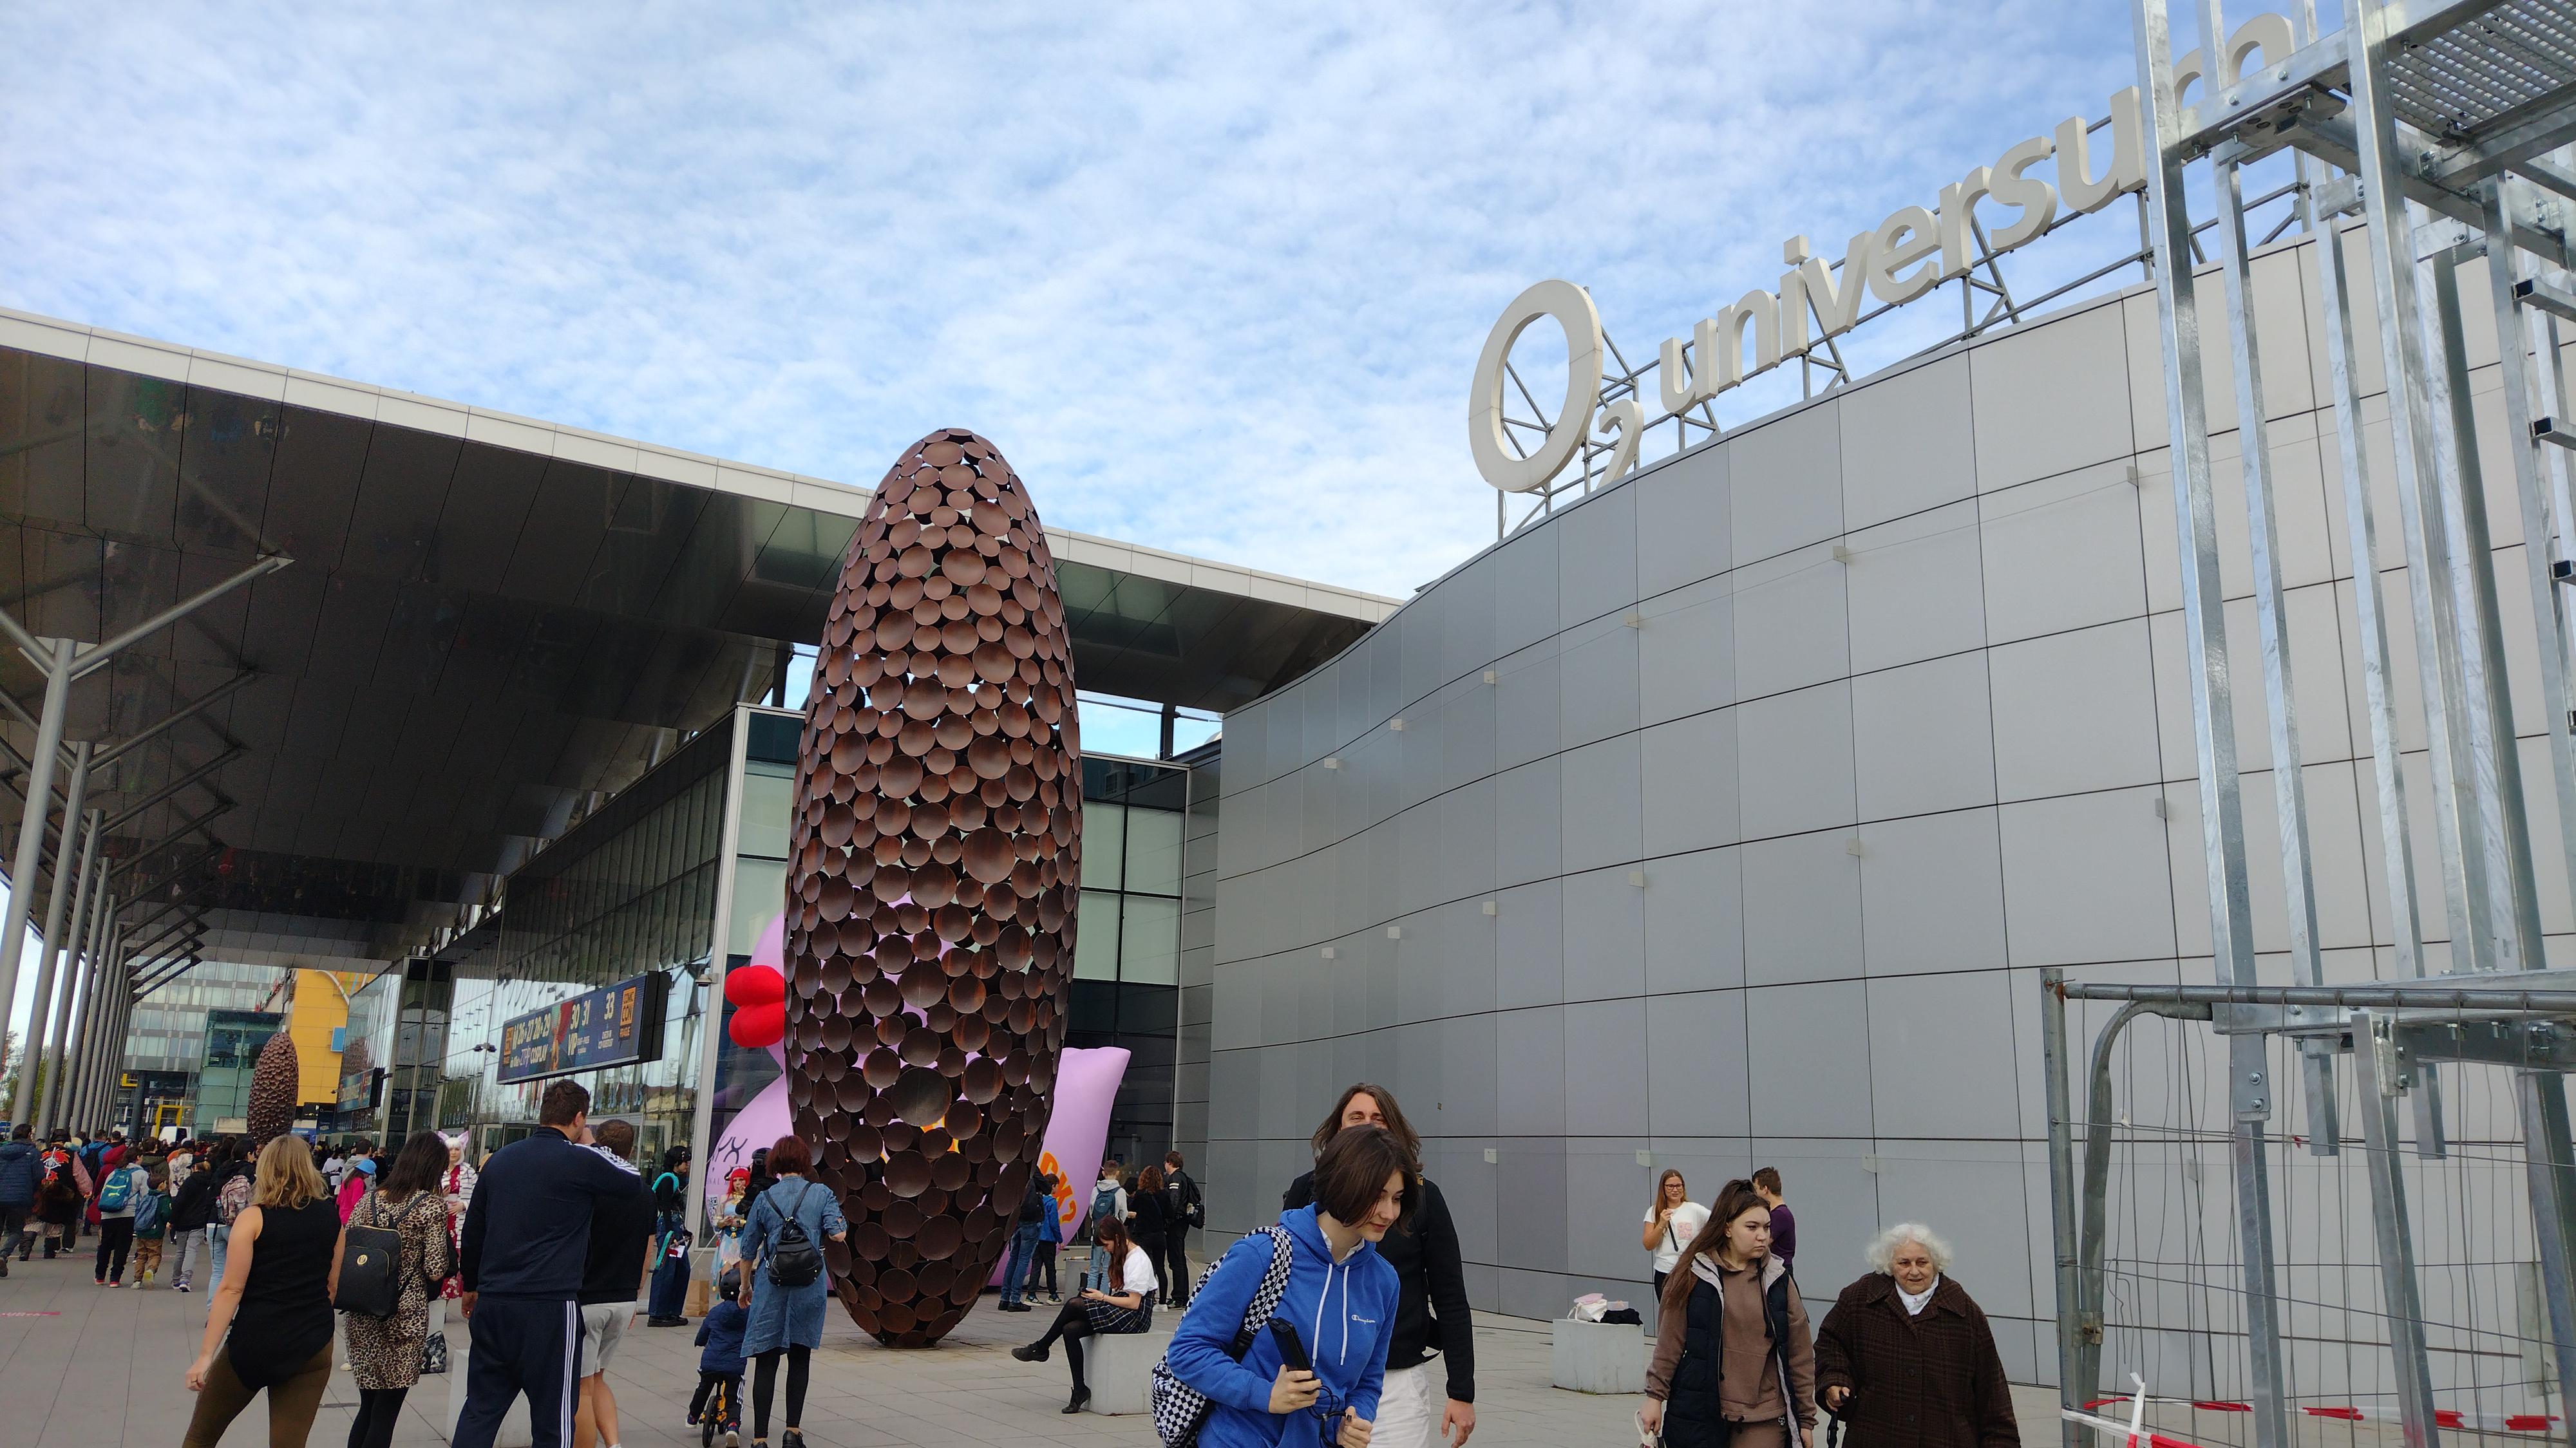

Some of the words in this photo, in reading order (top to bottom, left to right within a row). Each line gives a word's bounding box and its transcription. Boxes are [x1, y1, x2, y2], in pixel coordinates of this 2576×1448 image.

[570, 1003, 580, 1030] 30
[582, 999, 591, 1026] 31
[604, 992, 615, 1020] 33
[567, 1032, 578, 1056] VIP
[712, 1136, 748, 1165] YX
